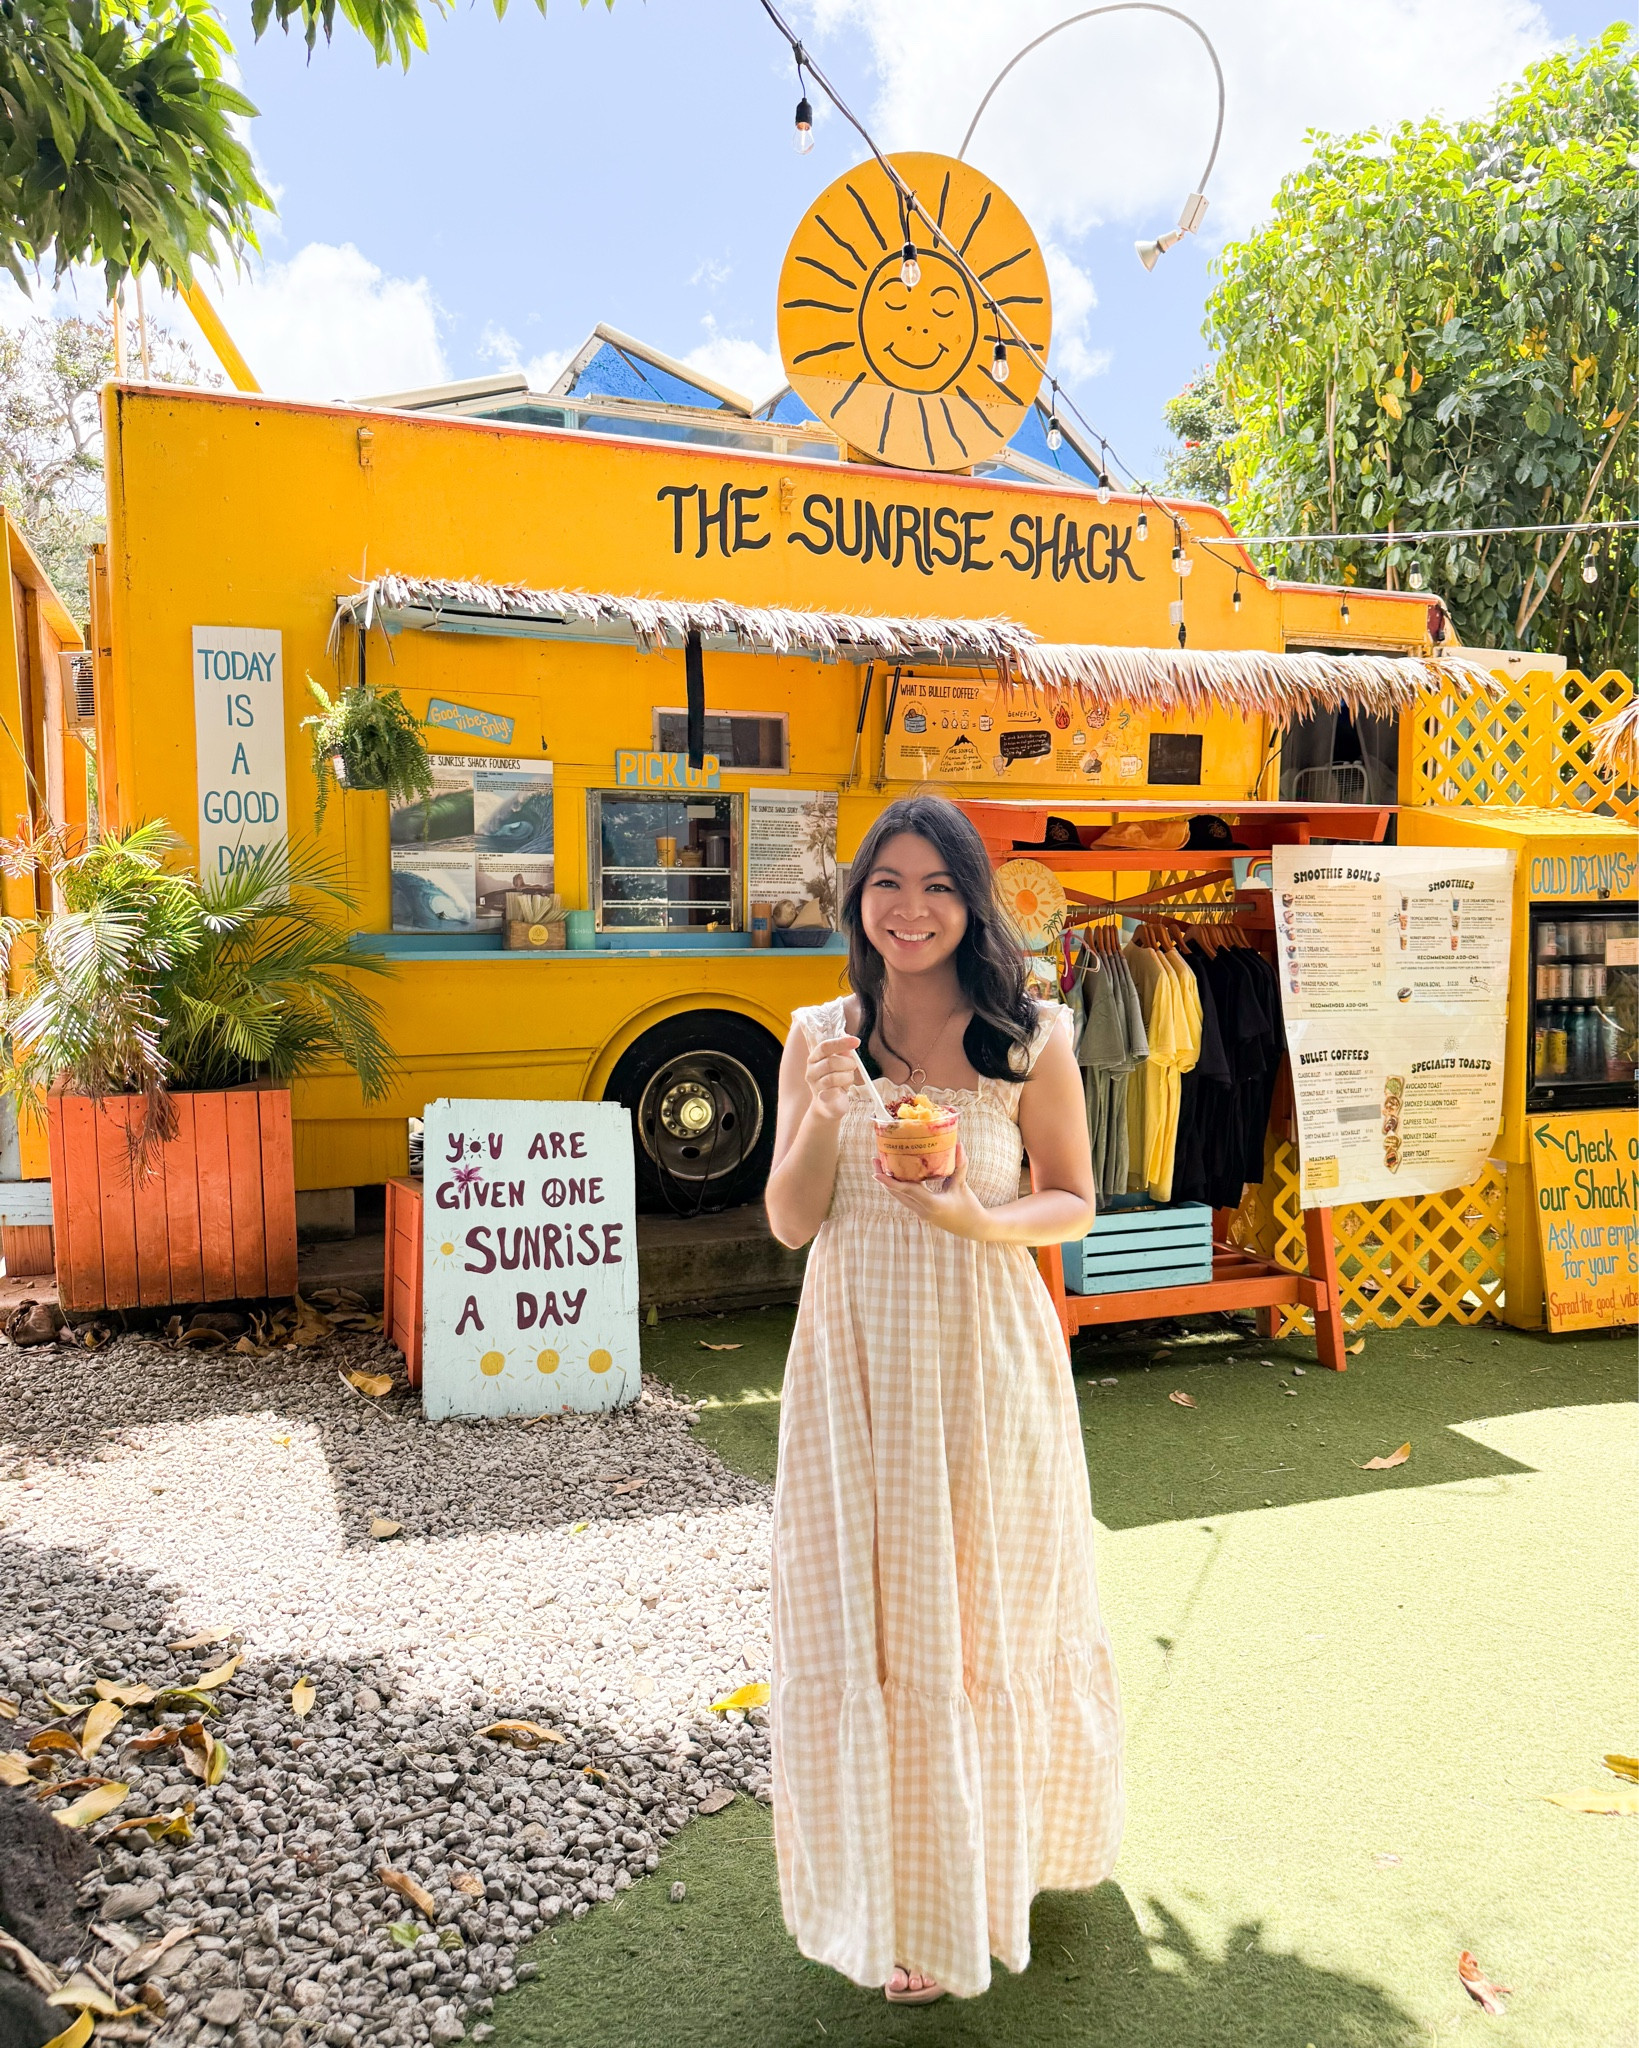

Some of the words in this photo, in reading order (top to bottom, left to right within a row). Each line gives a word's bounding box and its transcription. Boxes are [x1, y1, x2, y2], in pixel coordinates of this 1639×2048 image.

[657, 483, 771, 558] THE
[787, 493, 994, 576] SUNRISE
[1000, 512, 1146, 584] SHACK
[197, 649, 276, 682] TODAY
[900, 684, 917, 696] WHAT
[919, 685, 927, 697] IS
[928, 686, 951, 698] BULLET
[952, 687, 979, 700] COFFEE?
[226, 694, 254, 727] IS
[430, 705, 461, 723] Good
[455, 713, 488, 731] vibes
[481, 717, 512, 739] only!
[1007, 710, 1038, 718] BENEFITS
[231, 742, 250, 775] A
[438, 756, 465, 767] SUNRISE
[467, 757, 487, 769] SHACK
[489, 758, 521, 770] FOUNDERS
[619, 752, 682, 787] PICK
[685, 754, 720, 787] UP
[203, 790, 279, 824] GOOD
[787, 806, 798, 814] STORY
[218, 845, 266, 877] DAY
[1293, 868, 1343, 884] SMOOTHIE
[1347, 868, 1381, 884] BOWLS
[1531, 857, 1567, 895] COLD
[1570, 852, 1631, 895] DRINKS
[1428, 879, 1475, 893] SMOOTHIES
[1300, 1050, 1328, 1065] BULLET
[1331, 1049, 1369, 1061] COFFEES
[1411, 1058, 1456, 1074] SPECIALTY
[1459, 1058, 1492, 1070] TOASTS
[446, 1132, 503, 1163] YOU
[528, 1132, 587, 1160] ARE
[1565, 1129, 1617, 1164] Check
[436, 1178, 525, 1210] GIVEN
[541, 1177, 605, 1208] ONE
[1540, 1186, 1570, 1211] our
[1574, 1168, 1630, 1210] Shack
[1548, 1219, 1579, 1252] Ask
[1580, 1226, 1605, 1249] our
[1561, 1250, 1585, 1280] for
[1586, 1255, 1619, 1287] your
[455, 1295, 485, 1335] A
[516, 1288, 587, 1330] DAY
[1550, 1292, 1580, 1326] Spread
[1580, 1291, 1593, 1314] the
[1596, 1288, 1615, 1318] good
